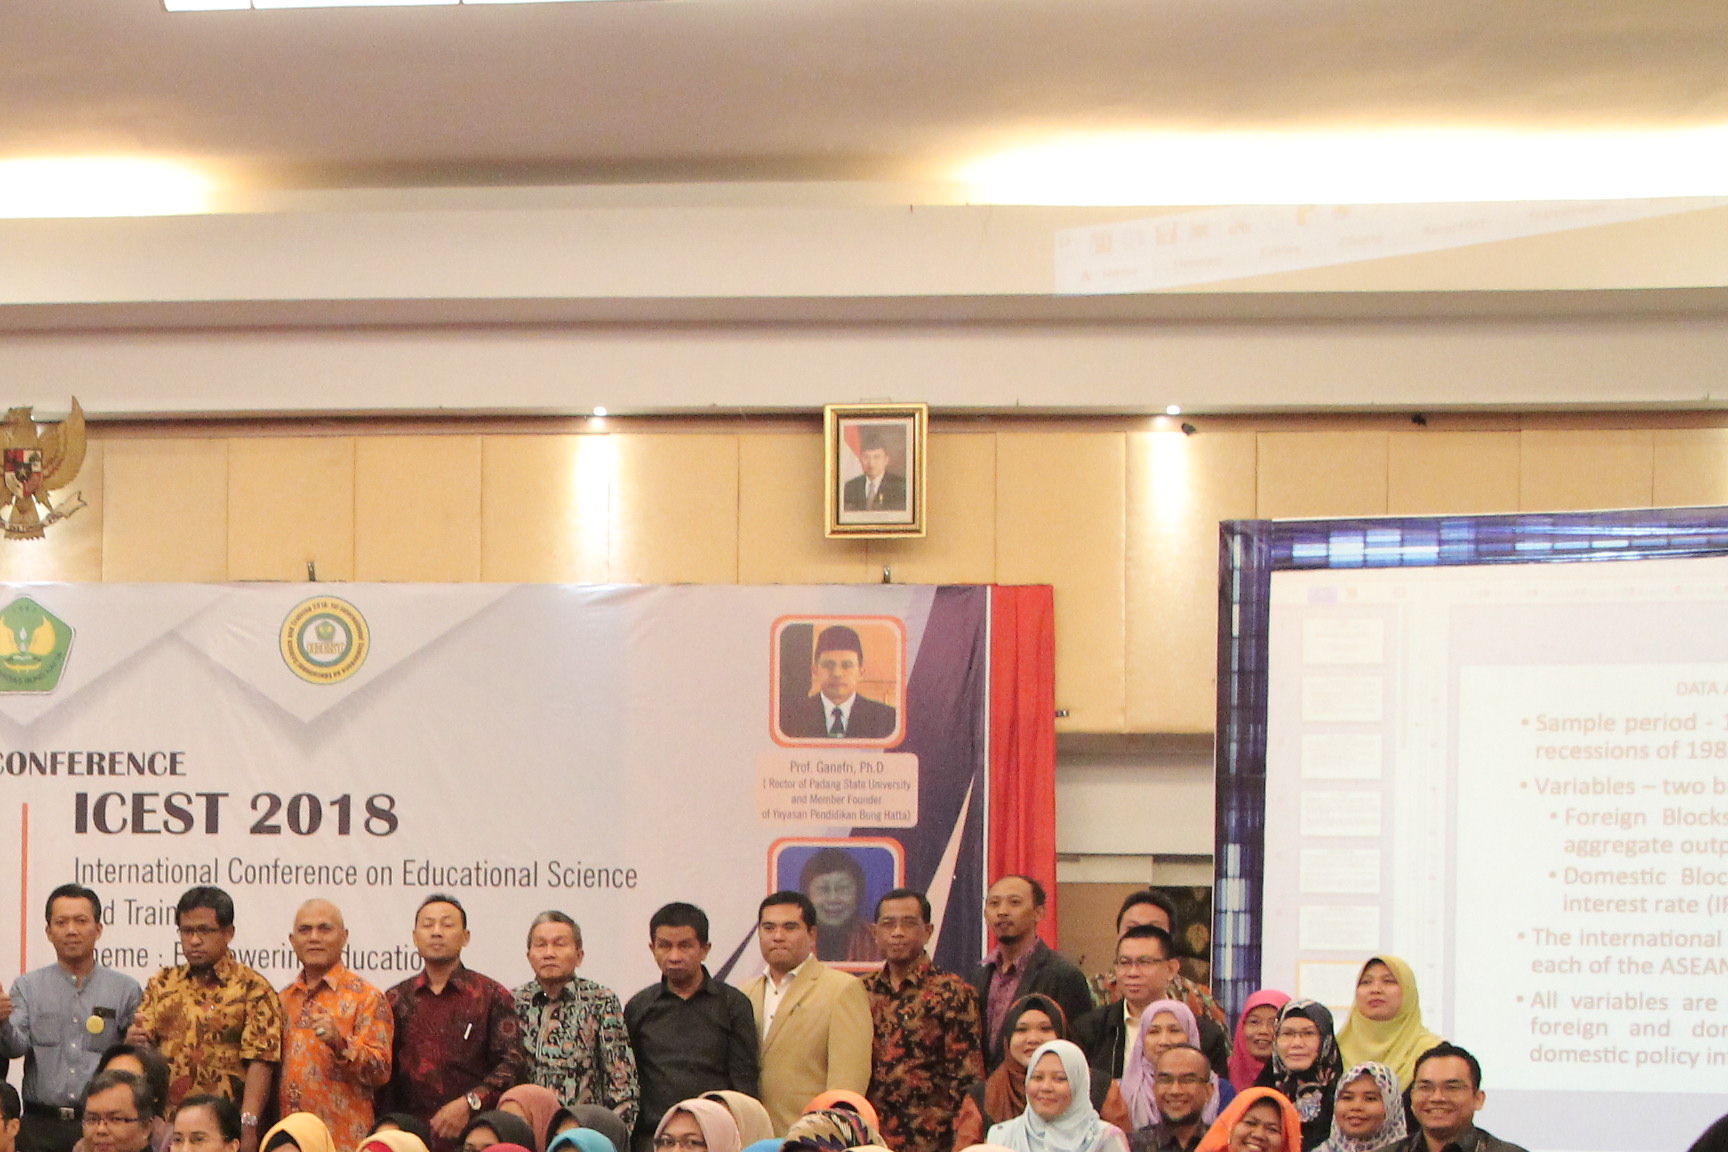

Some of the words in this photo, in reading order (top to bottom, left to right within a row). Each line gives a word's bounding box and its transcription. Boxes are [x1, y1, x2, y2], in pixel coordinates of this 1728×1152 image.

[1535, 713, 1616, 736] Sample
[1624, 712, 1697, 735] period
[1535, 741, 1650, 760] recessions
[1656, 740, 1679, 760] of
[859, 761, 884, 774] Ph.D
[843, 779, 866, 790] State
[868, 779, 911, 791] University
[1534, 776, 1636, 796] Variables
[1662, 778, 1706, 796] two
[791, 795, 807, 805] and
[74, 792, 229, 835] ICEST
[249, 793, 399, 836] 2018
[1565, 807, 1647, 830] Foreign
[1564, 836, 1674, 857] aggregate
[74, 857, 219, 885] International
[228, 857, 357, 886] Conference
[367, 864, 393, 887] on
[403, 859, 538, 888] Educational
[548, 861, 638, 888] Science
[1564, 866, 1667, 886] Domestic
[1563, 894, 1648, 913] interest
[1654, 896, 1700, 914] rate
[1532, 928, 1572, 946] The
[1579, 928, 1722, 949] international
[1531, 956, 1582, 975] each
[1589, 955, 1612, 975] of
[1618, 957, 1654, 976] the
[1530, 990, 1558, 1009] All
[1571, 991, 1669, 1011] variables
[1682, 997, 1718, 1012] are
[1530, 1016, 1609, 1040] foreign
[1629, 1019, 1672, 1038] and
[1529, 1043, 1630, 1064] domestic
[1636, 1045, 1701, 1069] policy
